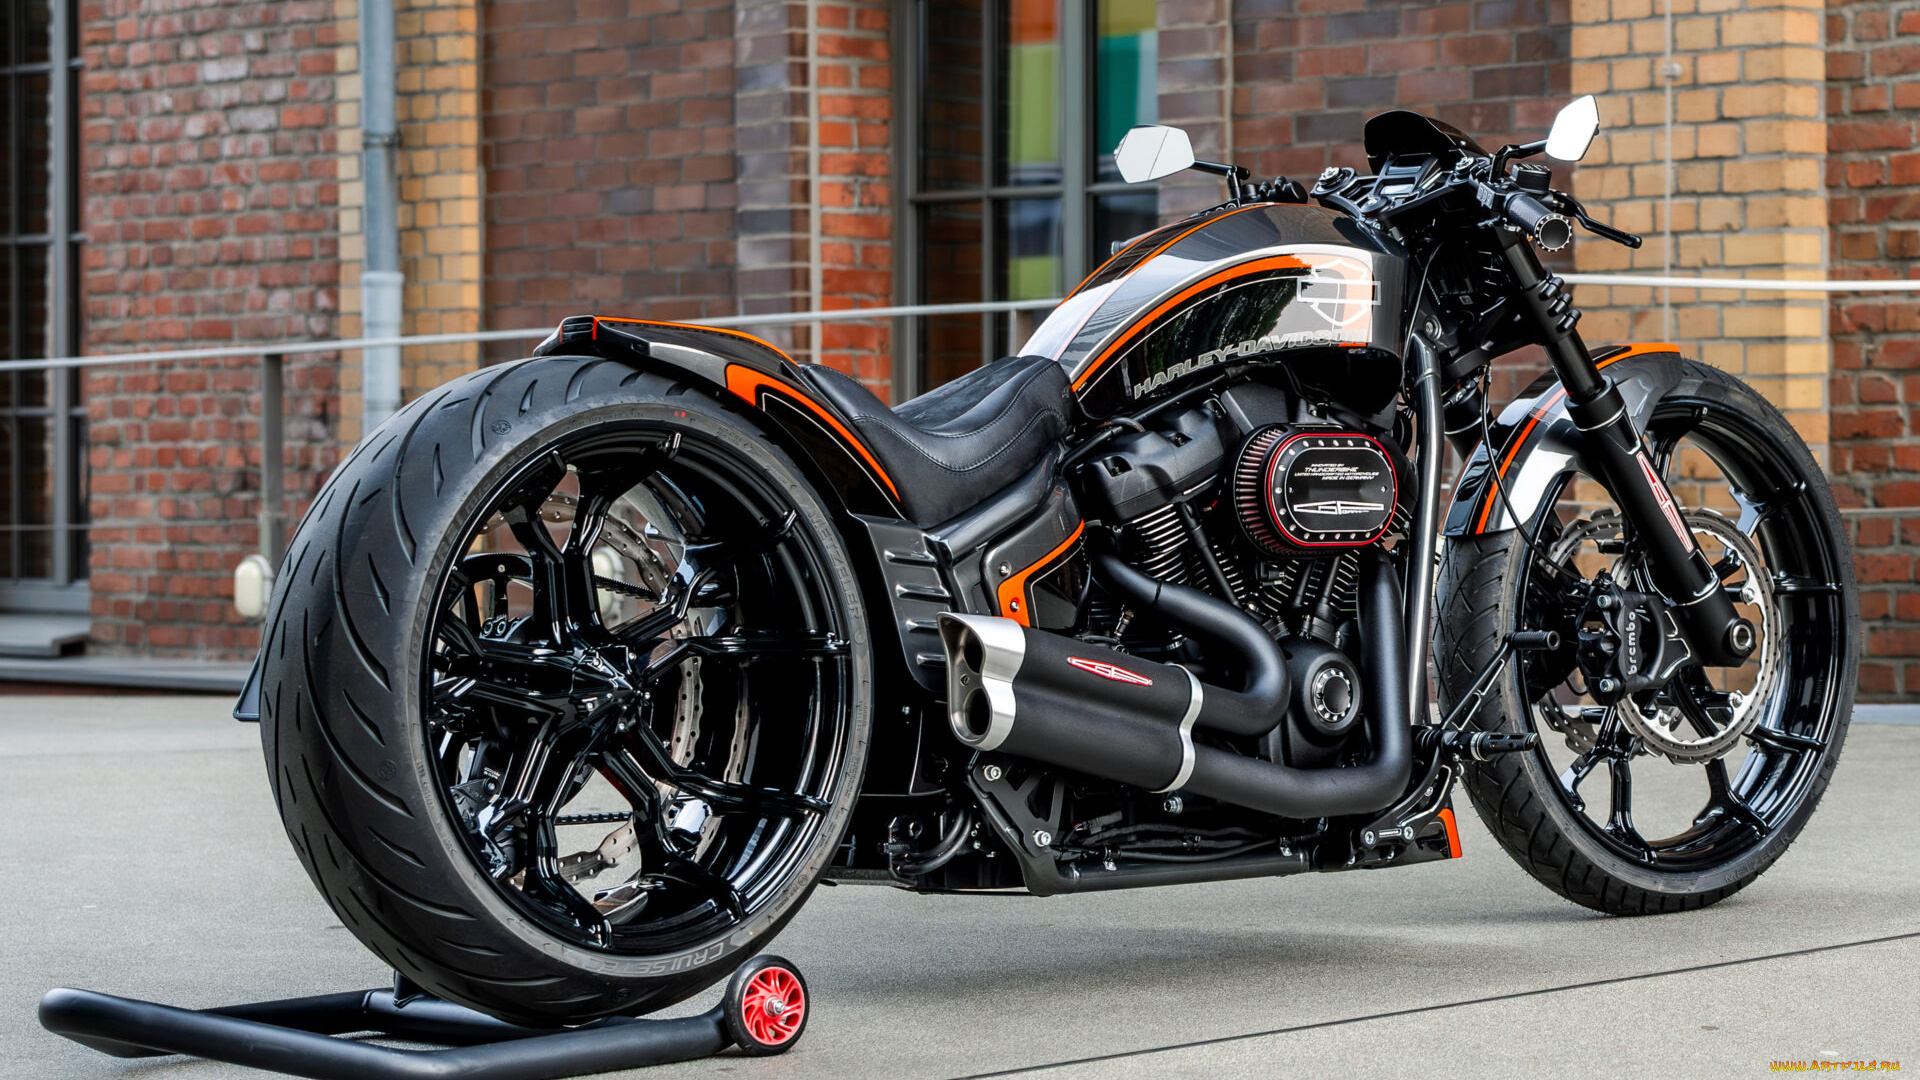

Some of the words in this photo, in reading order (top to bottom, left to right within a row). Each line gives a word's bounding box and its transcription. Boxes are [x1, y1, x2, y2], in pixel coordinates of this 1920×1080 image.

[1134, 329, 1366, 400] HARLEY-DAVIDSON
[806, 508, 863, 621] METZELER
[1625, 611, 1638, 675] brembo
